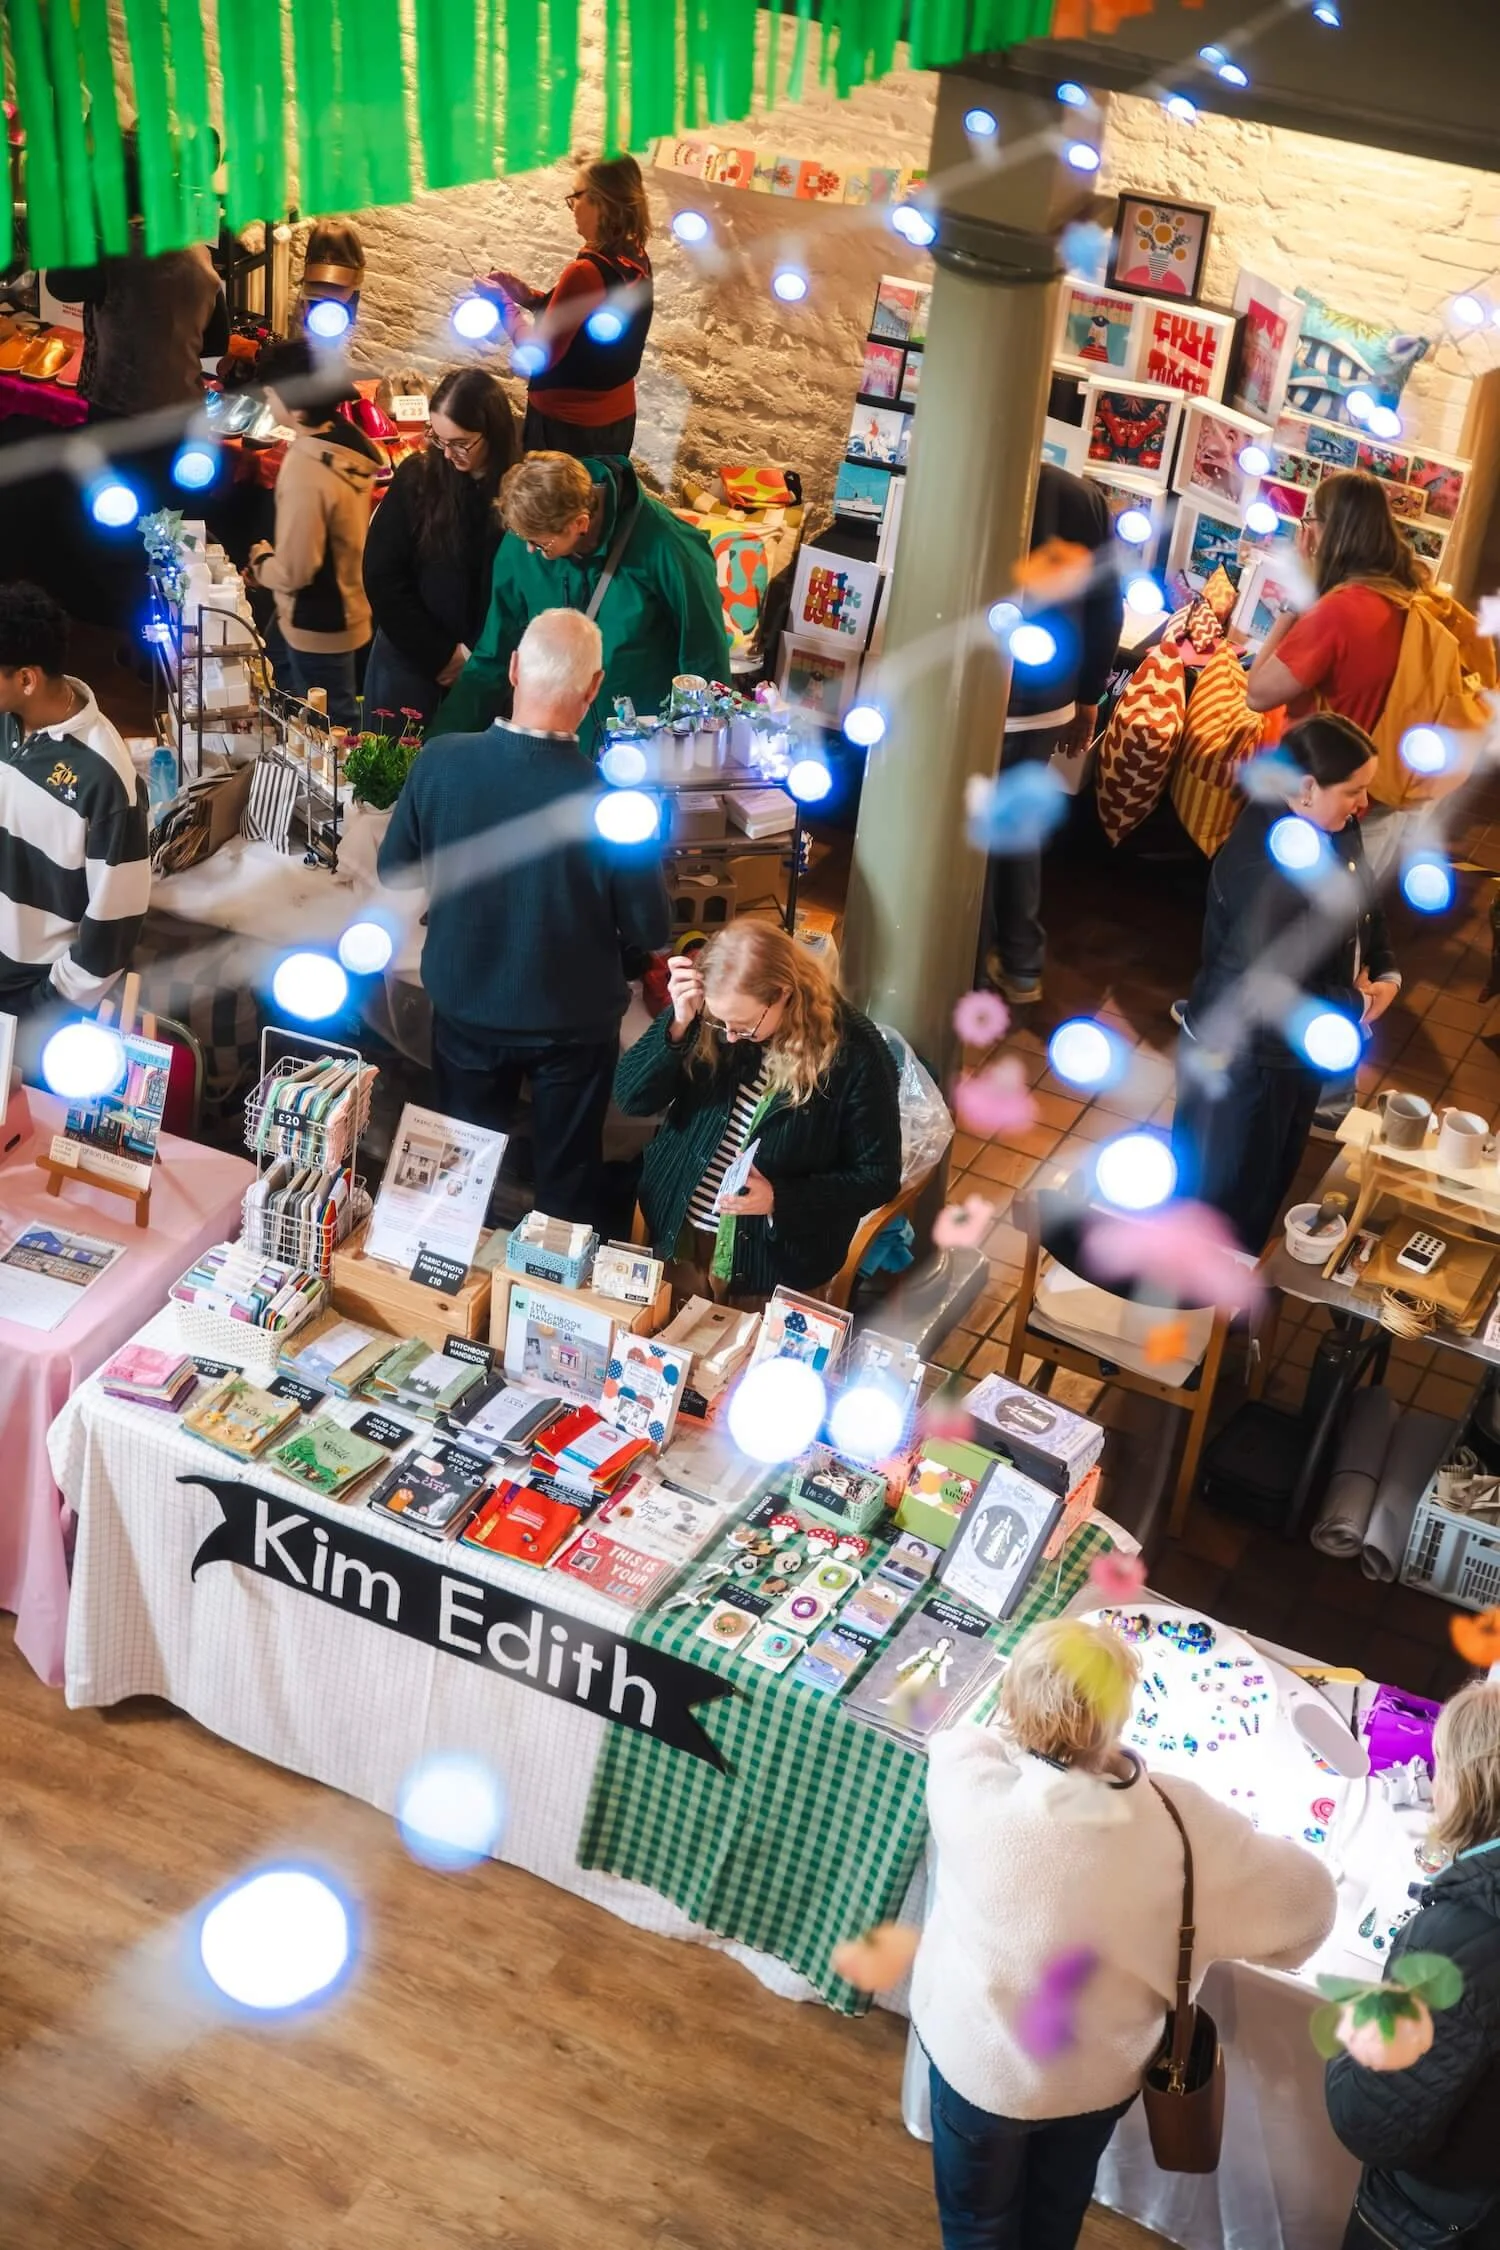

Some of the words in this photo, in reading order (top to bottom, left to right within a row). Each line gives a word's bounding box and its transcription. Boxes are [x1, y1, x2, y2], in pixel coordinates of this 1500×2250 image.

[1154, 311, 1217, 344] FULL
[811, 566, 848, 588] art
[278, 1113, 300, 1127] £20
[419, 1262, 448, 1276] PRINTING
[448, 1273, 460, 1281] KIT
[420, 1254, 442, 1266] FABRIC
[442, 1262, 464, 1274] PHOTO
[428, 1276, 442, 1286] £10
[531, 1301, 546, 1310] THE
[449, 1340, 490, 1358] STITCHBOOK
[450, 1349, 486, 1364] HANDBOOK
[280, 1386, 300, 1397] BEACH
[300, 1393, 313, 1401] KIT
[299, 1387, 312, 1395] THE
[366, 1421, 389, 1434] WOODS
[388, 1431, 400, 1439] KIT
[372, 1418, 389, 1427] INTO
[389, 1424, 403, 1433] THE
[447, 1455, 465, 1466] CATS
[464, 1463, 476, 1471] KIT
[454, 1452, 473, 1464] BOOK
[608, 1545, 642, 1567] THIS
[641, 1560, 659, 1573] IS
[610, 1563, 649, 1587] YOUR
[606, 1580, 639, 1597] LIFE
[254, 1498, 402, 1622] Kim
[438, 1575, 658, 1728] Edith
[932, 1600, 964, 1617] REGENCY
[963, 1614, 987, 1628] GOWN
[936, 1608, 962, 1623] DESIGN
[961, 1619, 975, 1628] KIT
[838, 1628, 858, 1640] CARD
[858, 1635, 873, 1645] SET
